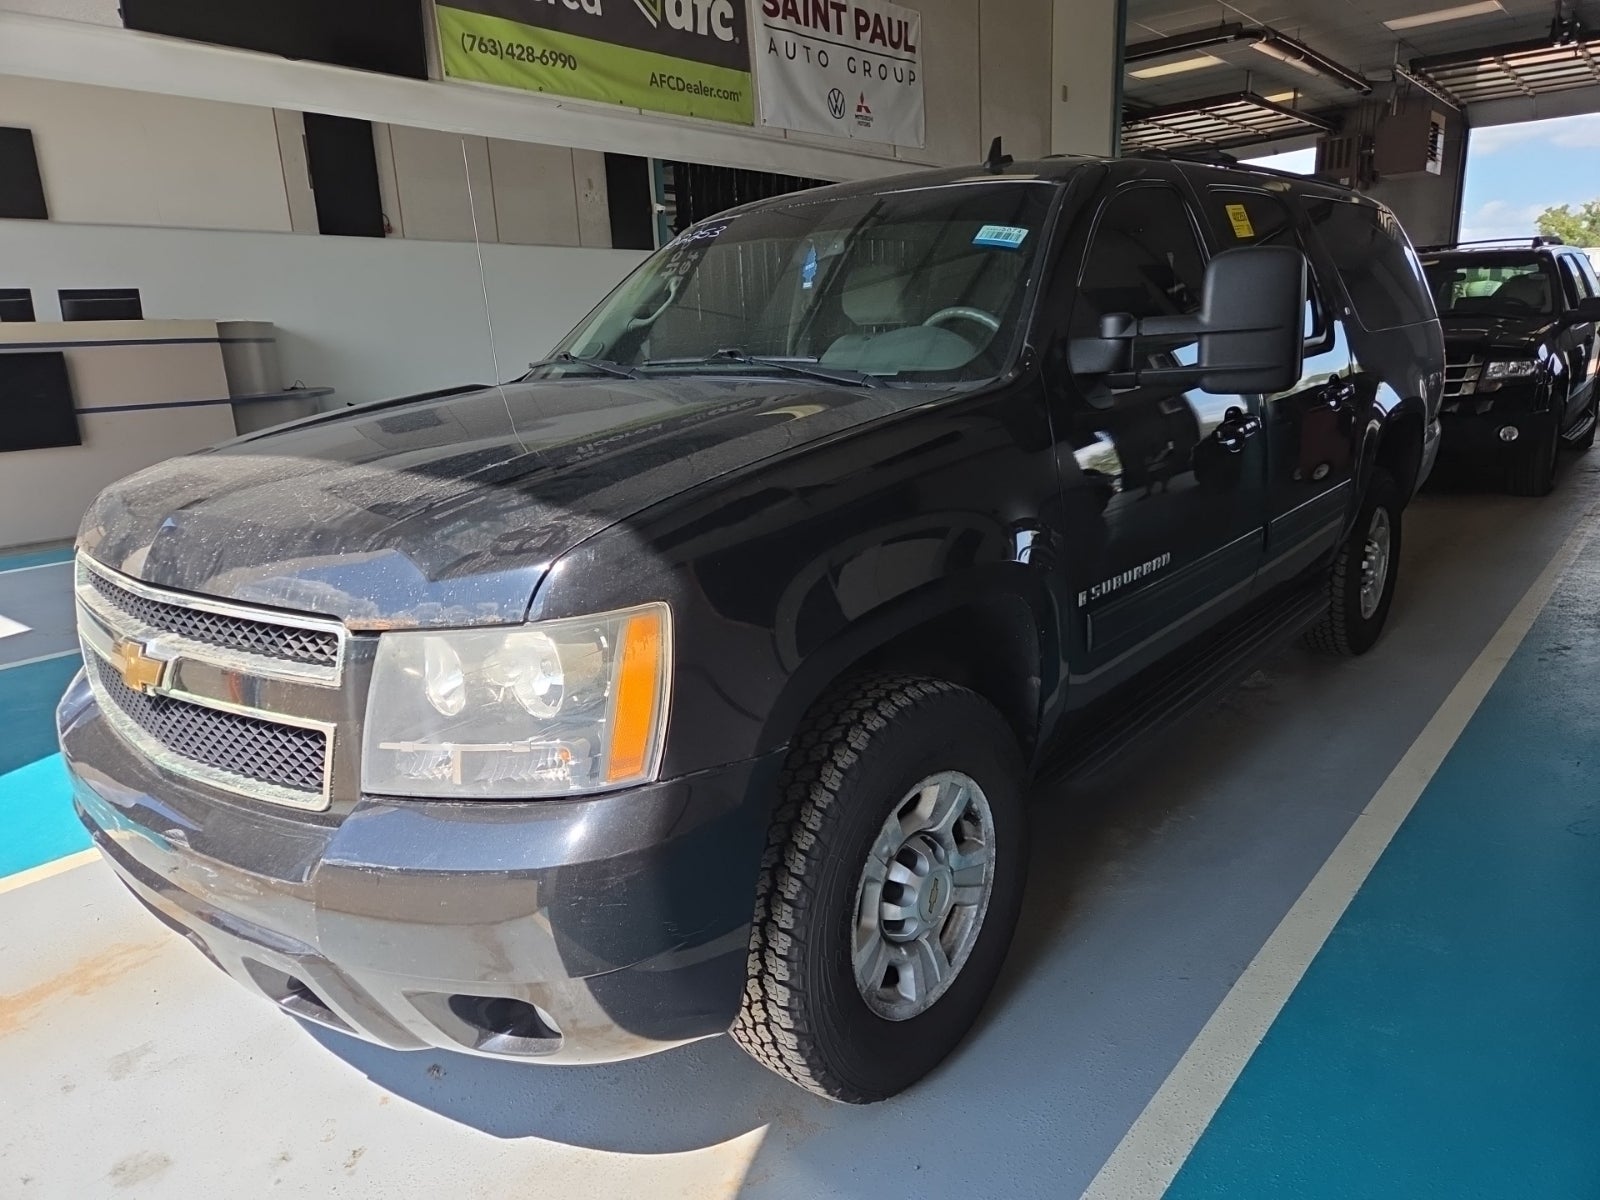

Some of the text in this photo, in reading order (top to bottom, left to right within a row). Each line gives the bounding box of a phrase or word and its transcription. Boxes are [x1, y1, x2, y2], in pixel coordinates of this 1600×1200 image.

[762, 0, 916, 54] SAINT PAUL
[768, 36, 916, 86] AUTO GROUP
[1091, 551, 1171, 601] SUBURBAN
